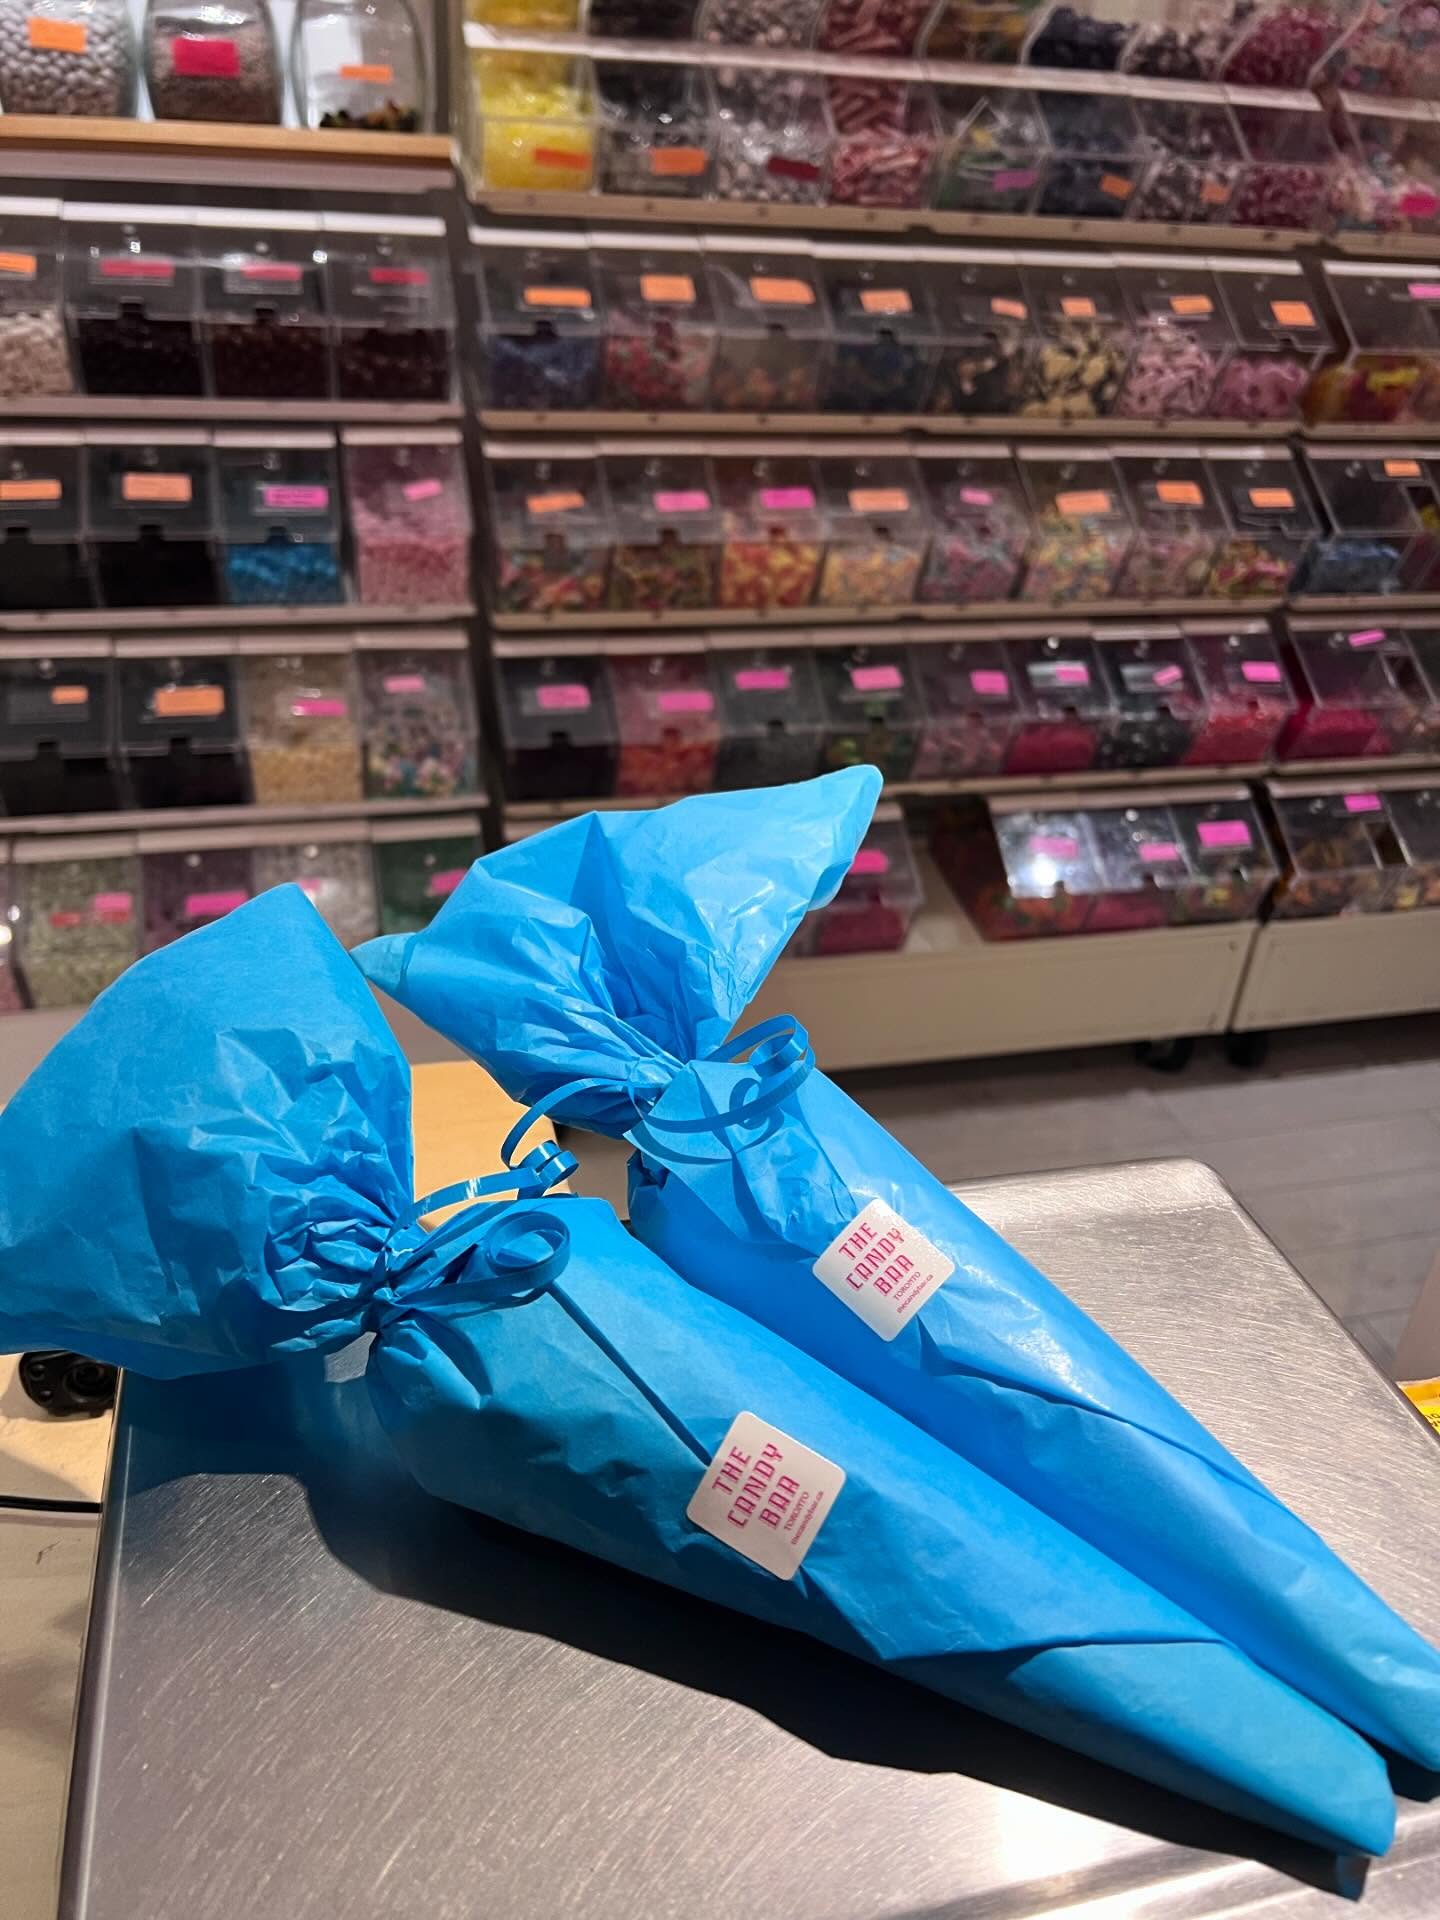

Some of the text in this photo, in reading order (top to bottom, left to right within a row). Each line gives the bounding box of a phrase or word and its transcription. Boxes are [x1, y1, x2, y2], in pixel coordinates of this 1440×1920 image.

[838, 1222, 878, 1260] THE
[845, 1227, 905, 1291] CANDY
[873, 1254, 914, 1297] BAR
[893, 1271, 921, 1301] TORONTO
[712, 1446, 751, 1495] THE
[727, 1443, 783, 1528] CANDY
[759, 1475, 800, 1529] BAR
[784, 1491, 809, 1531] TORONTO
